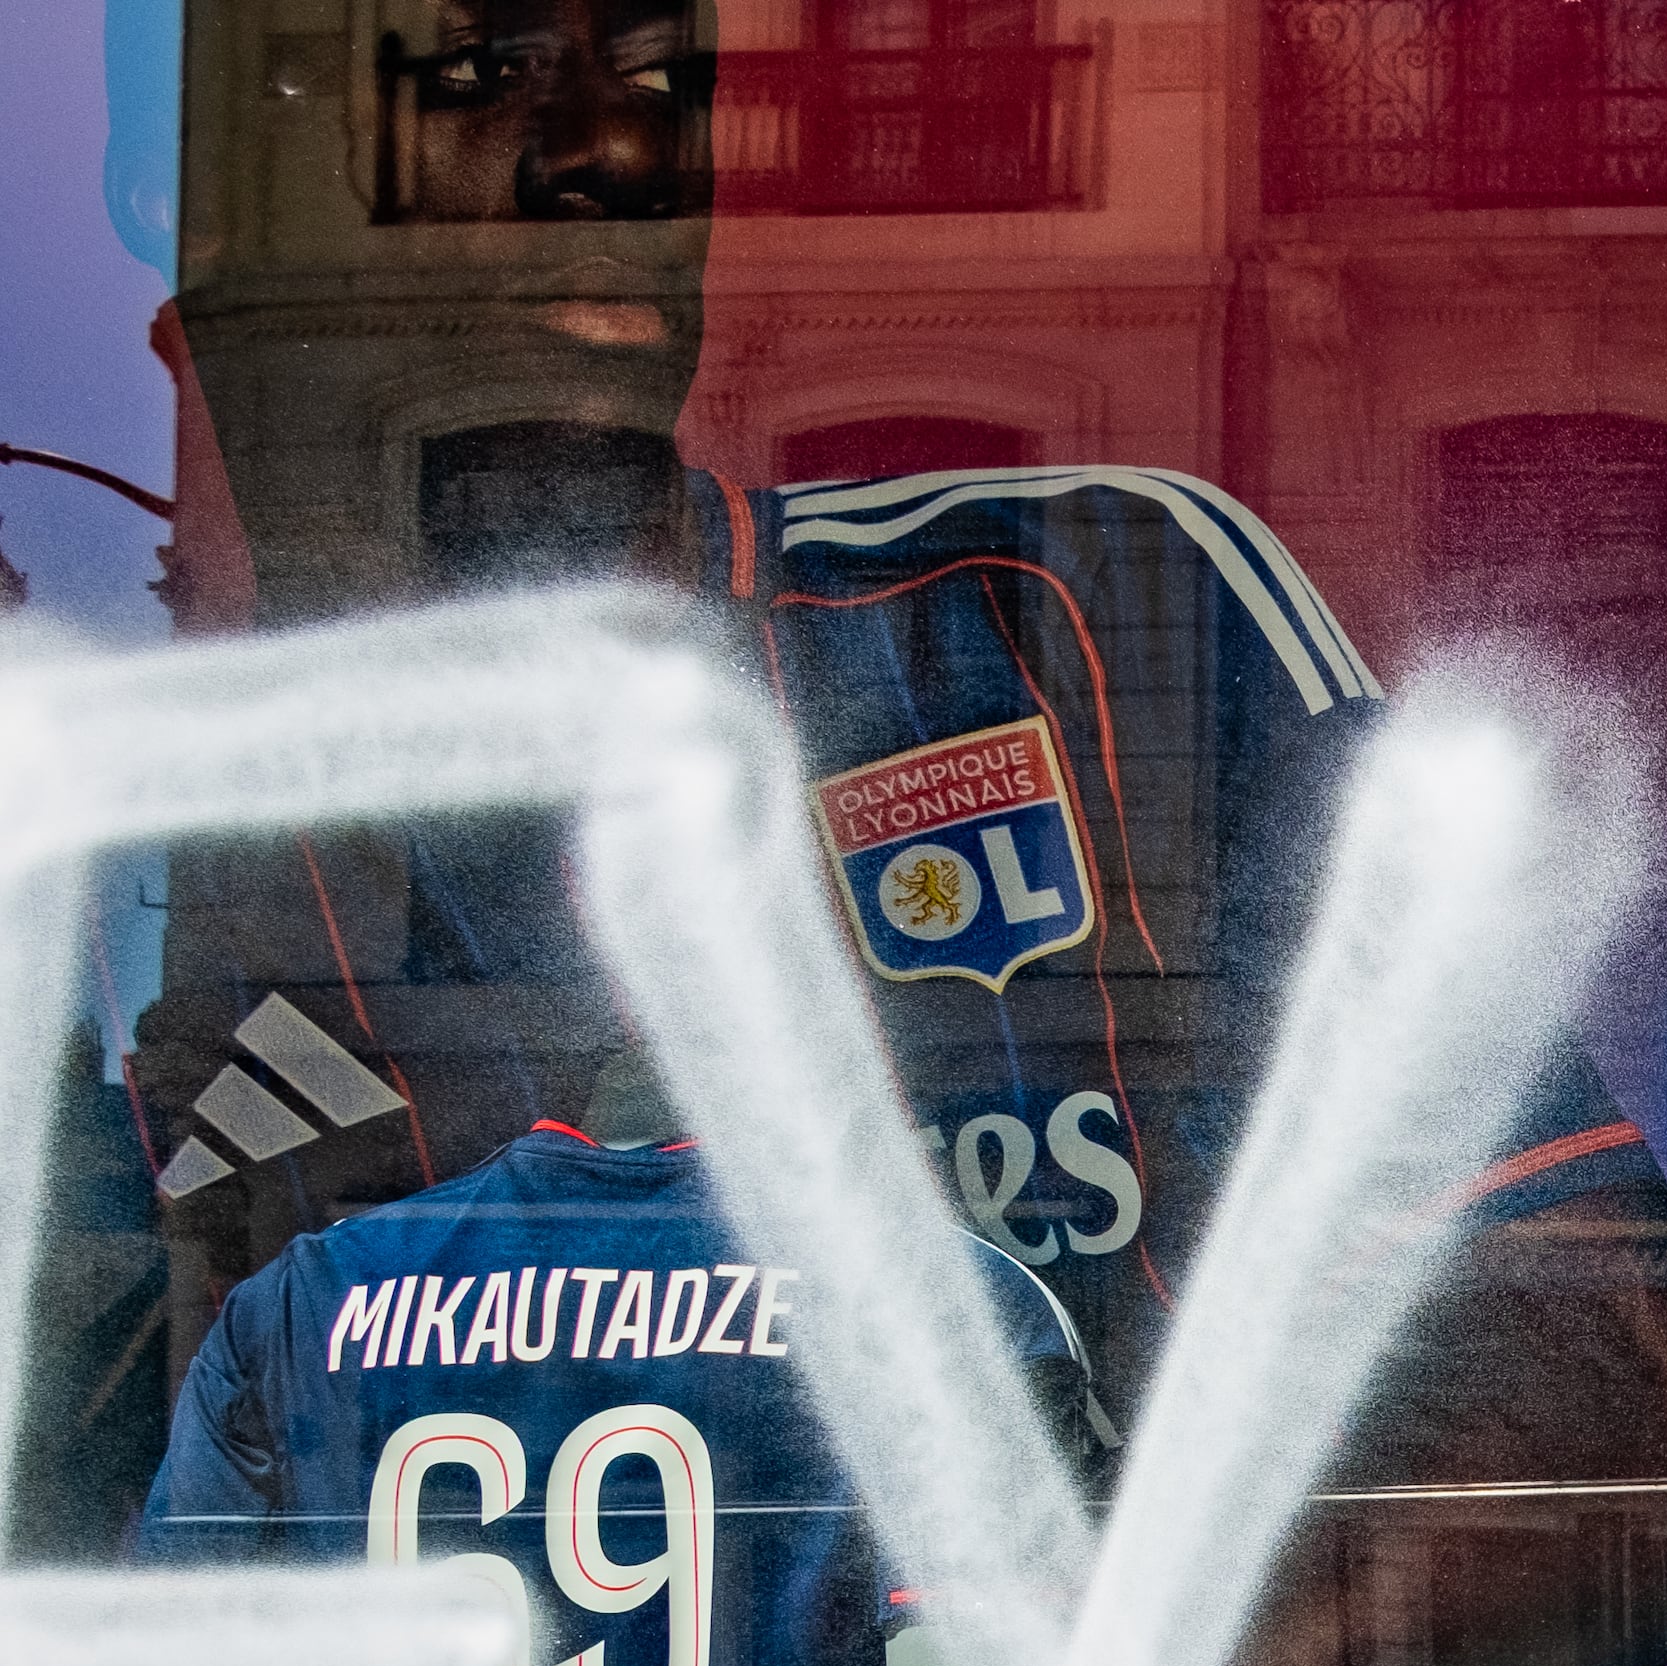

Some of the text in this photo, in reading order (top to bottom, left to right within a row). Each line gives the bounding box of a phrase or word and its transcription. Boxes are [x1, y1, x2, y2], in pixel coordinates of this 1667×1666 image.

[837, 739, 1031, 816] OLYMPIQUE
[847, 768, 1037, 843] LYONNAIS
[327, 1263, 800, 1373] MIKAUTADZE
